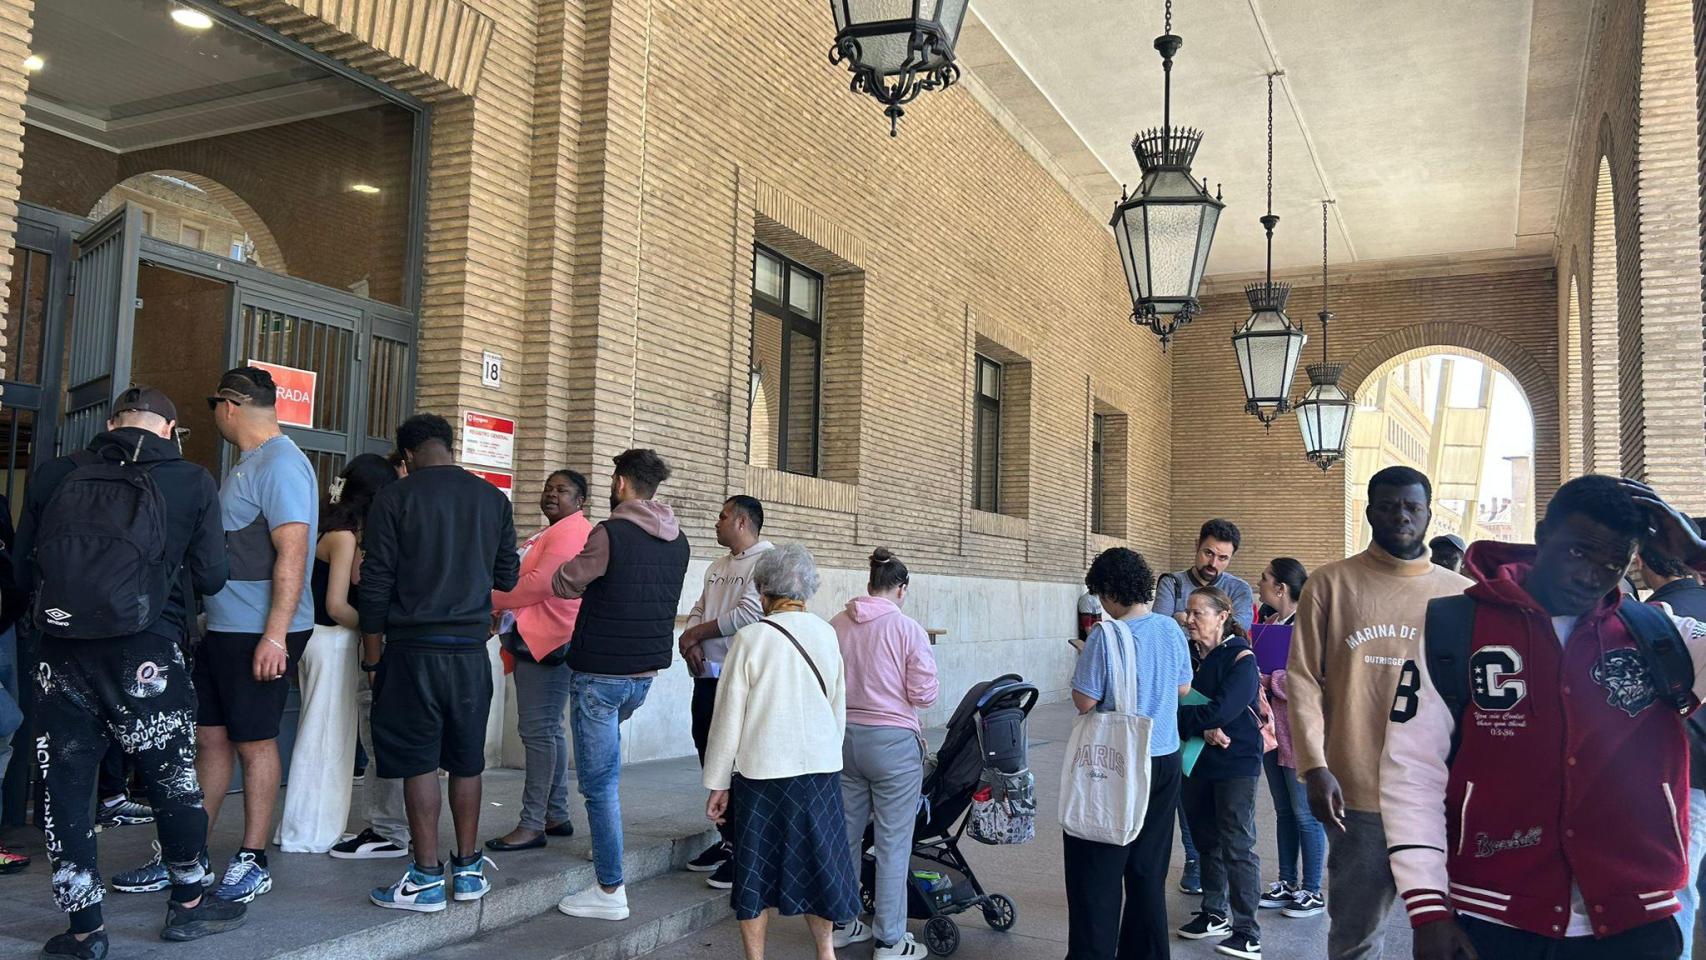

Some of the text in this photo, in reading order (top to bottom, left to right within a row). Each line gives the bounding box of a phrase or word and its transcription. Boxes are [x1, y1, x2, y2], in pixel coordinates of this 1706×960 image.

[485, 361, 499, 381] 18
[275, 386, 311, 403] RADA
[1345, 624, 1417, 650] MARINA DE
[1364, 655, 1405, 666] OUTRIGGE
[1071, 744, 1125, 778] PARIS
